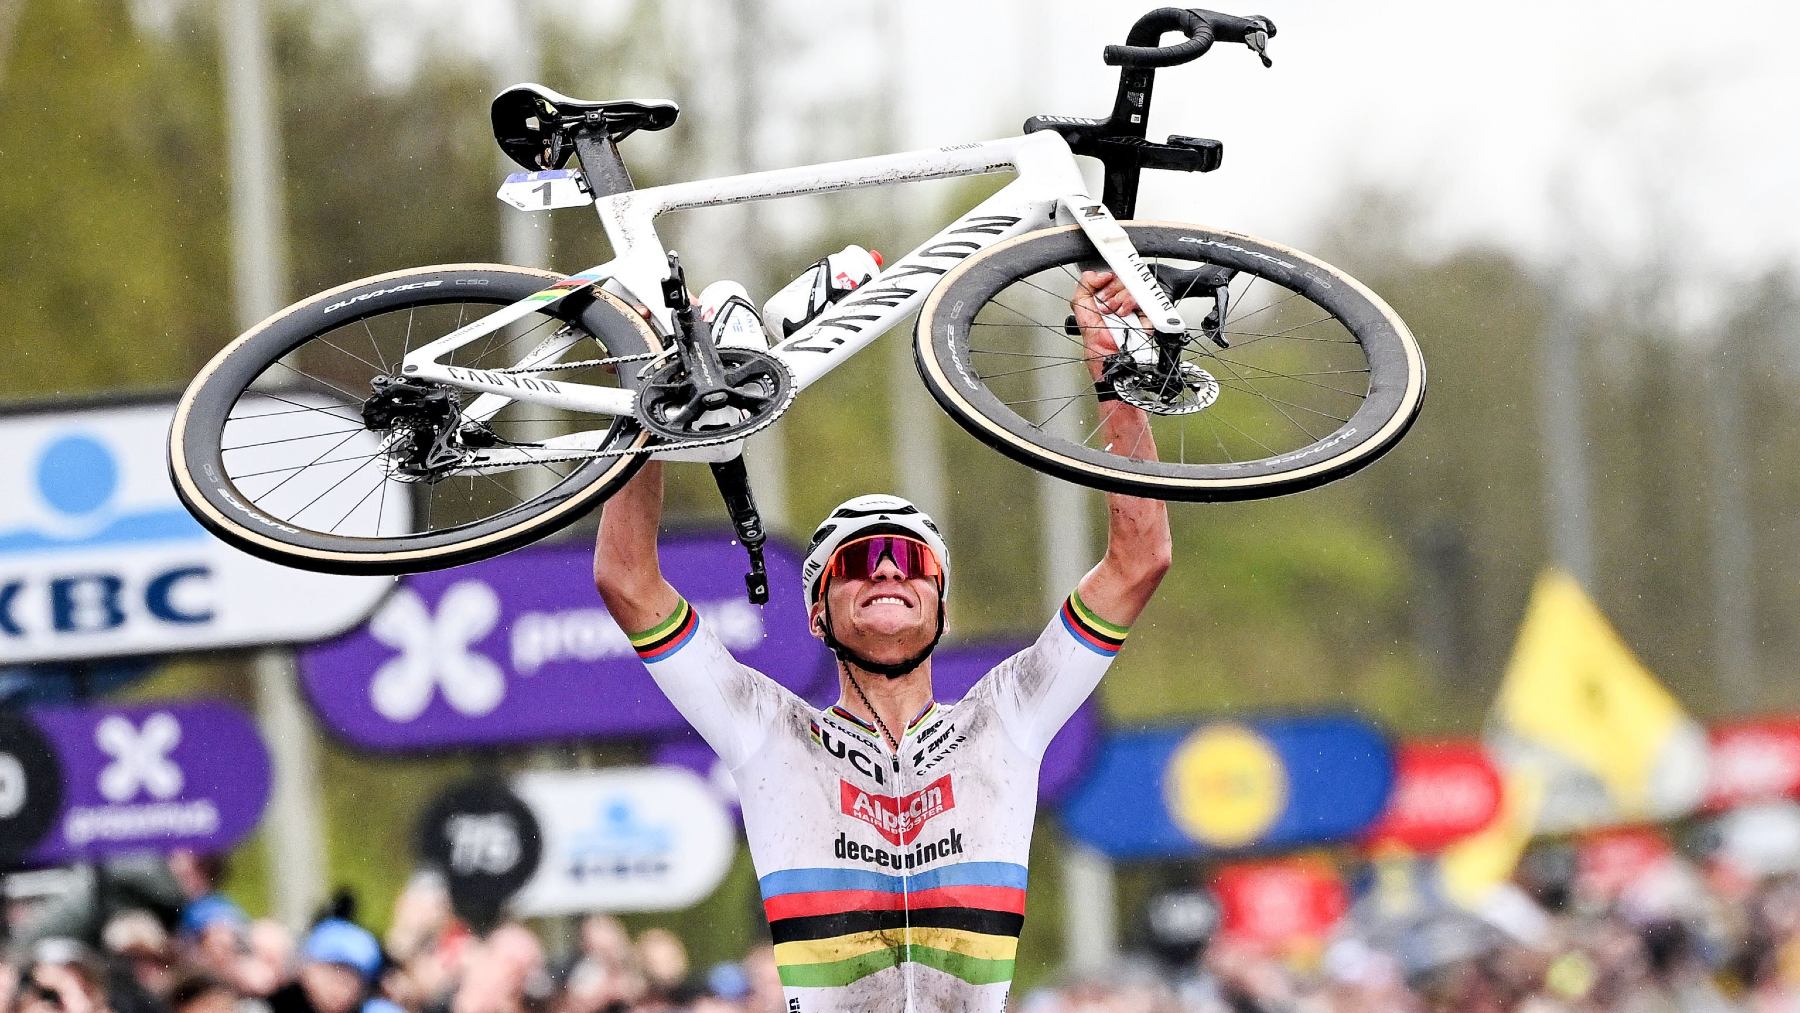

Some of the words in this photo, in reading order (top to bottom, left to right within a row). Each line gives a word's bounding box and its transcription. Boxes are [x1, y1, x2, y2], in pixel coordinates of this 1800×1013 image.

[532, 181, 552, 206] 1
[324, 280, 444, 313] DURA-ACE
[783, 215, 1022, 354] CANYON
[1128, 252, 1173, 312] CANYON
[447, 367, 561, 394] CANYON
[822, 729, 884, 786] UCI
[916, 736, 966, 776] CANYON
[928, 723, 955, 753] ZWIFT
[853, 786, 942, 832] Alpecin
[834, 828, 964, 870] deceuninck
